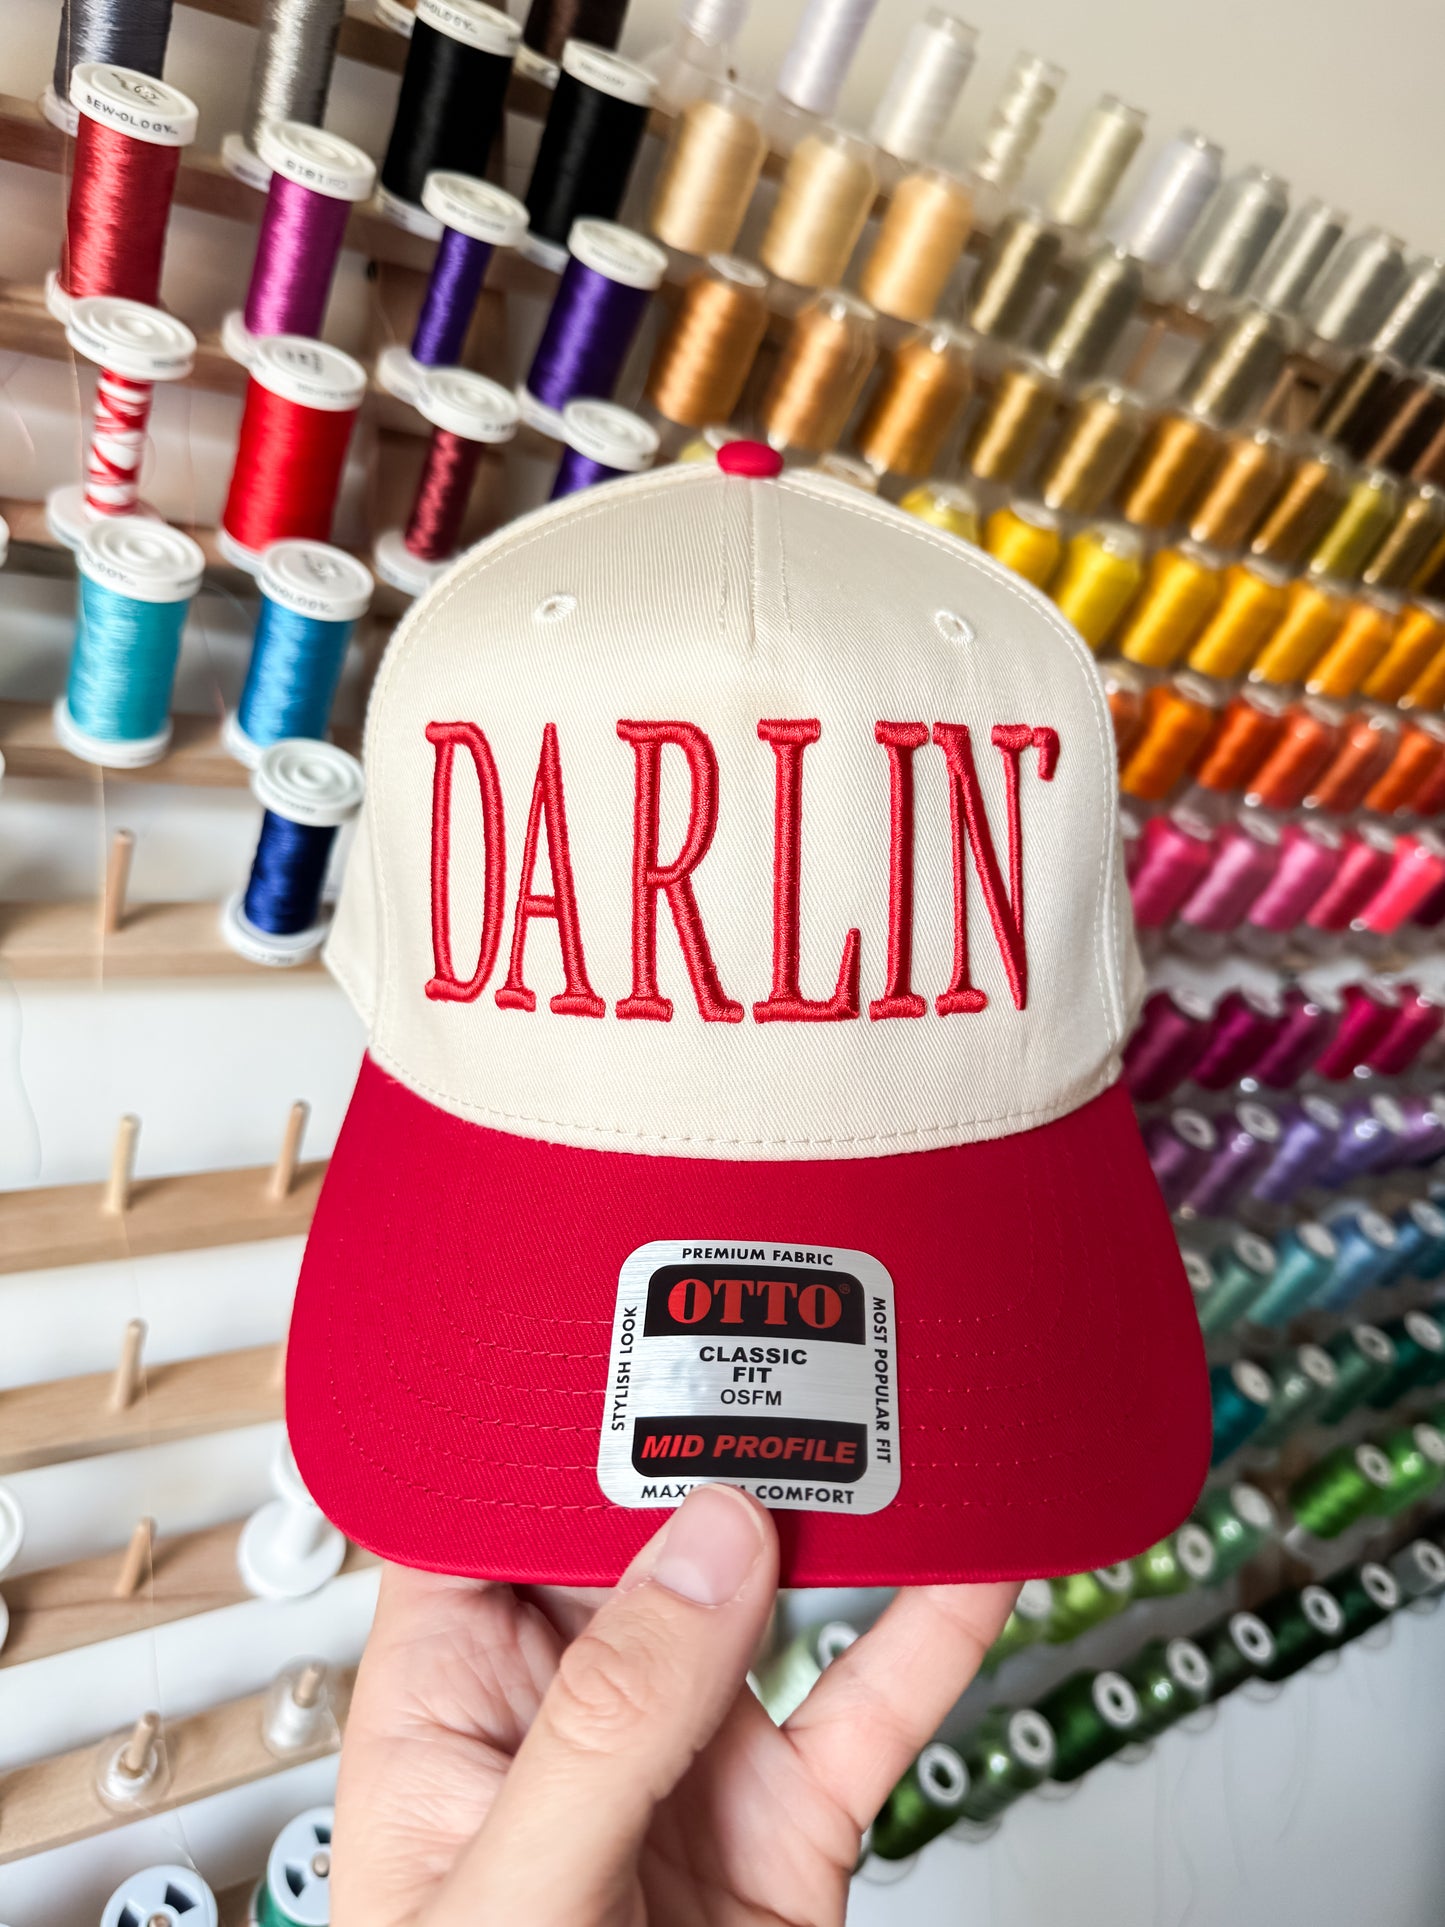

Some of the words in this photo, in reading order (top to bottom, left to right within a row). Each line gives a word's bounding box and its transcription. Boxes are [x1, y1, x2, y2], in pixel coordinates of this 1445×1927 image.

[682, 1247, 766, 1261] PREMIUM
[772, 1250, 833, 1266] FABRIC
[620, 1306, 638, 1354] LOOK
[872, 1296, 888, 1343] MOST
[699, 1345, 808, 1366] CLASSIC
[732, 1366, 772, 1384] FIT
[611, 1361, 632, 1431] STYLISH
[720, 1389, 782, 1406] OSFM
[873, 1348, 890, 1432] POPULAR
[641, 1434, 705, 1459] MID
[712, 1435, 858, 1465] PROFILE
[876, 1438, 891, 1464] FIT
[755, 1485, 855, 1505] COMFORT
